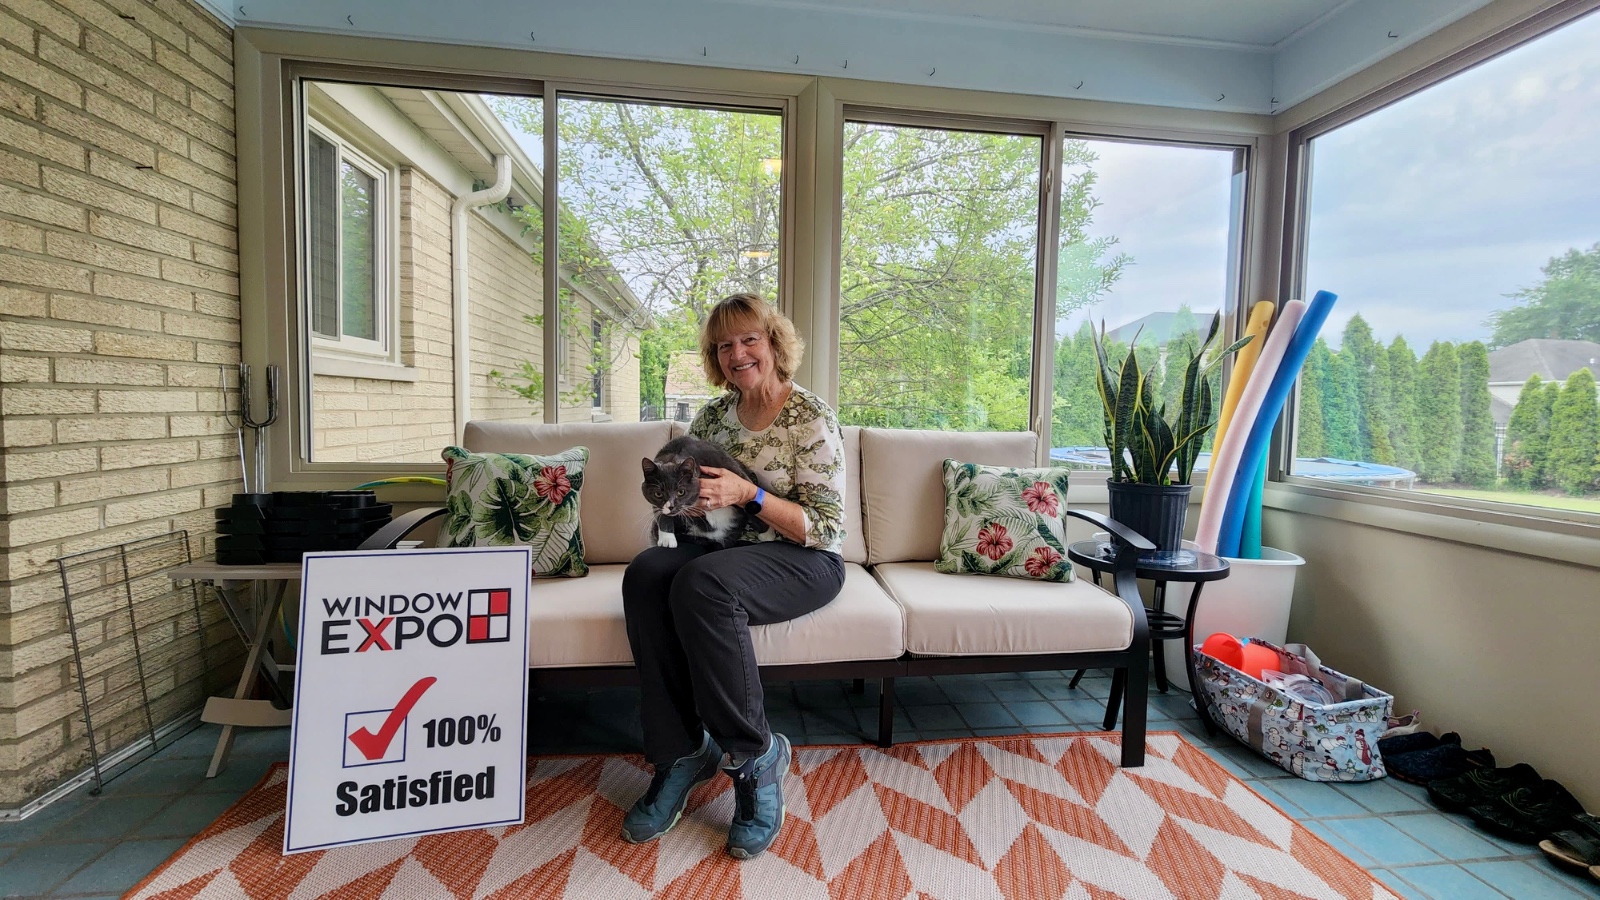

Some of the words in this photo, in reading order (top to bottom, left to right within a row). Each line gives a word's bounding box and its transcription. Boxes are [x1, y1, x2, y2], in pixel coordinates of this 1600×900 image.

[322, 592, 464, 618] WINDOW
[320, 613, 464, 655] EXPO
[422, 713, 502, 749] 100%
[336, 765, 496, 817] Satisfied
